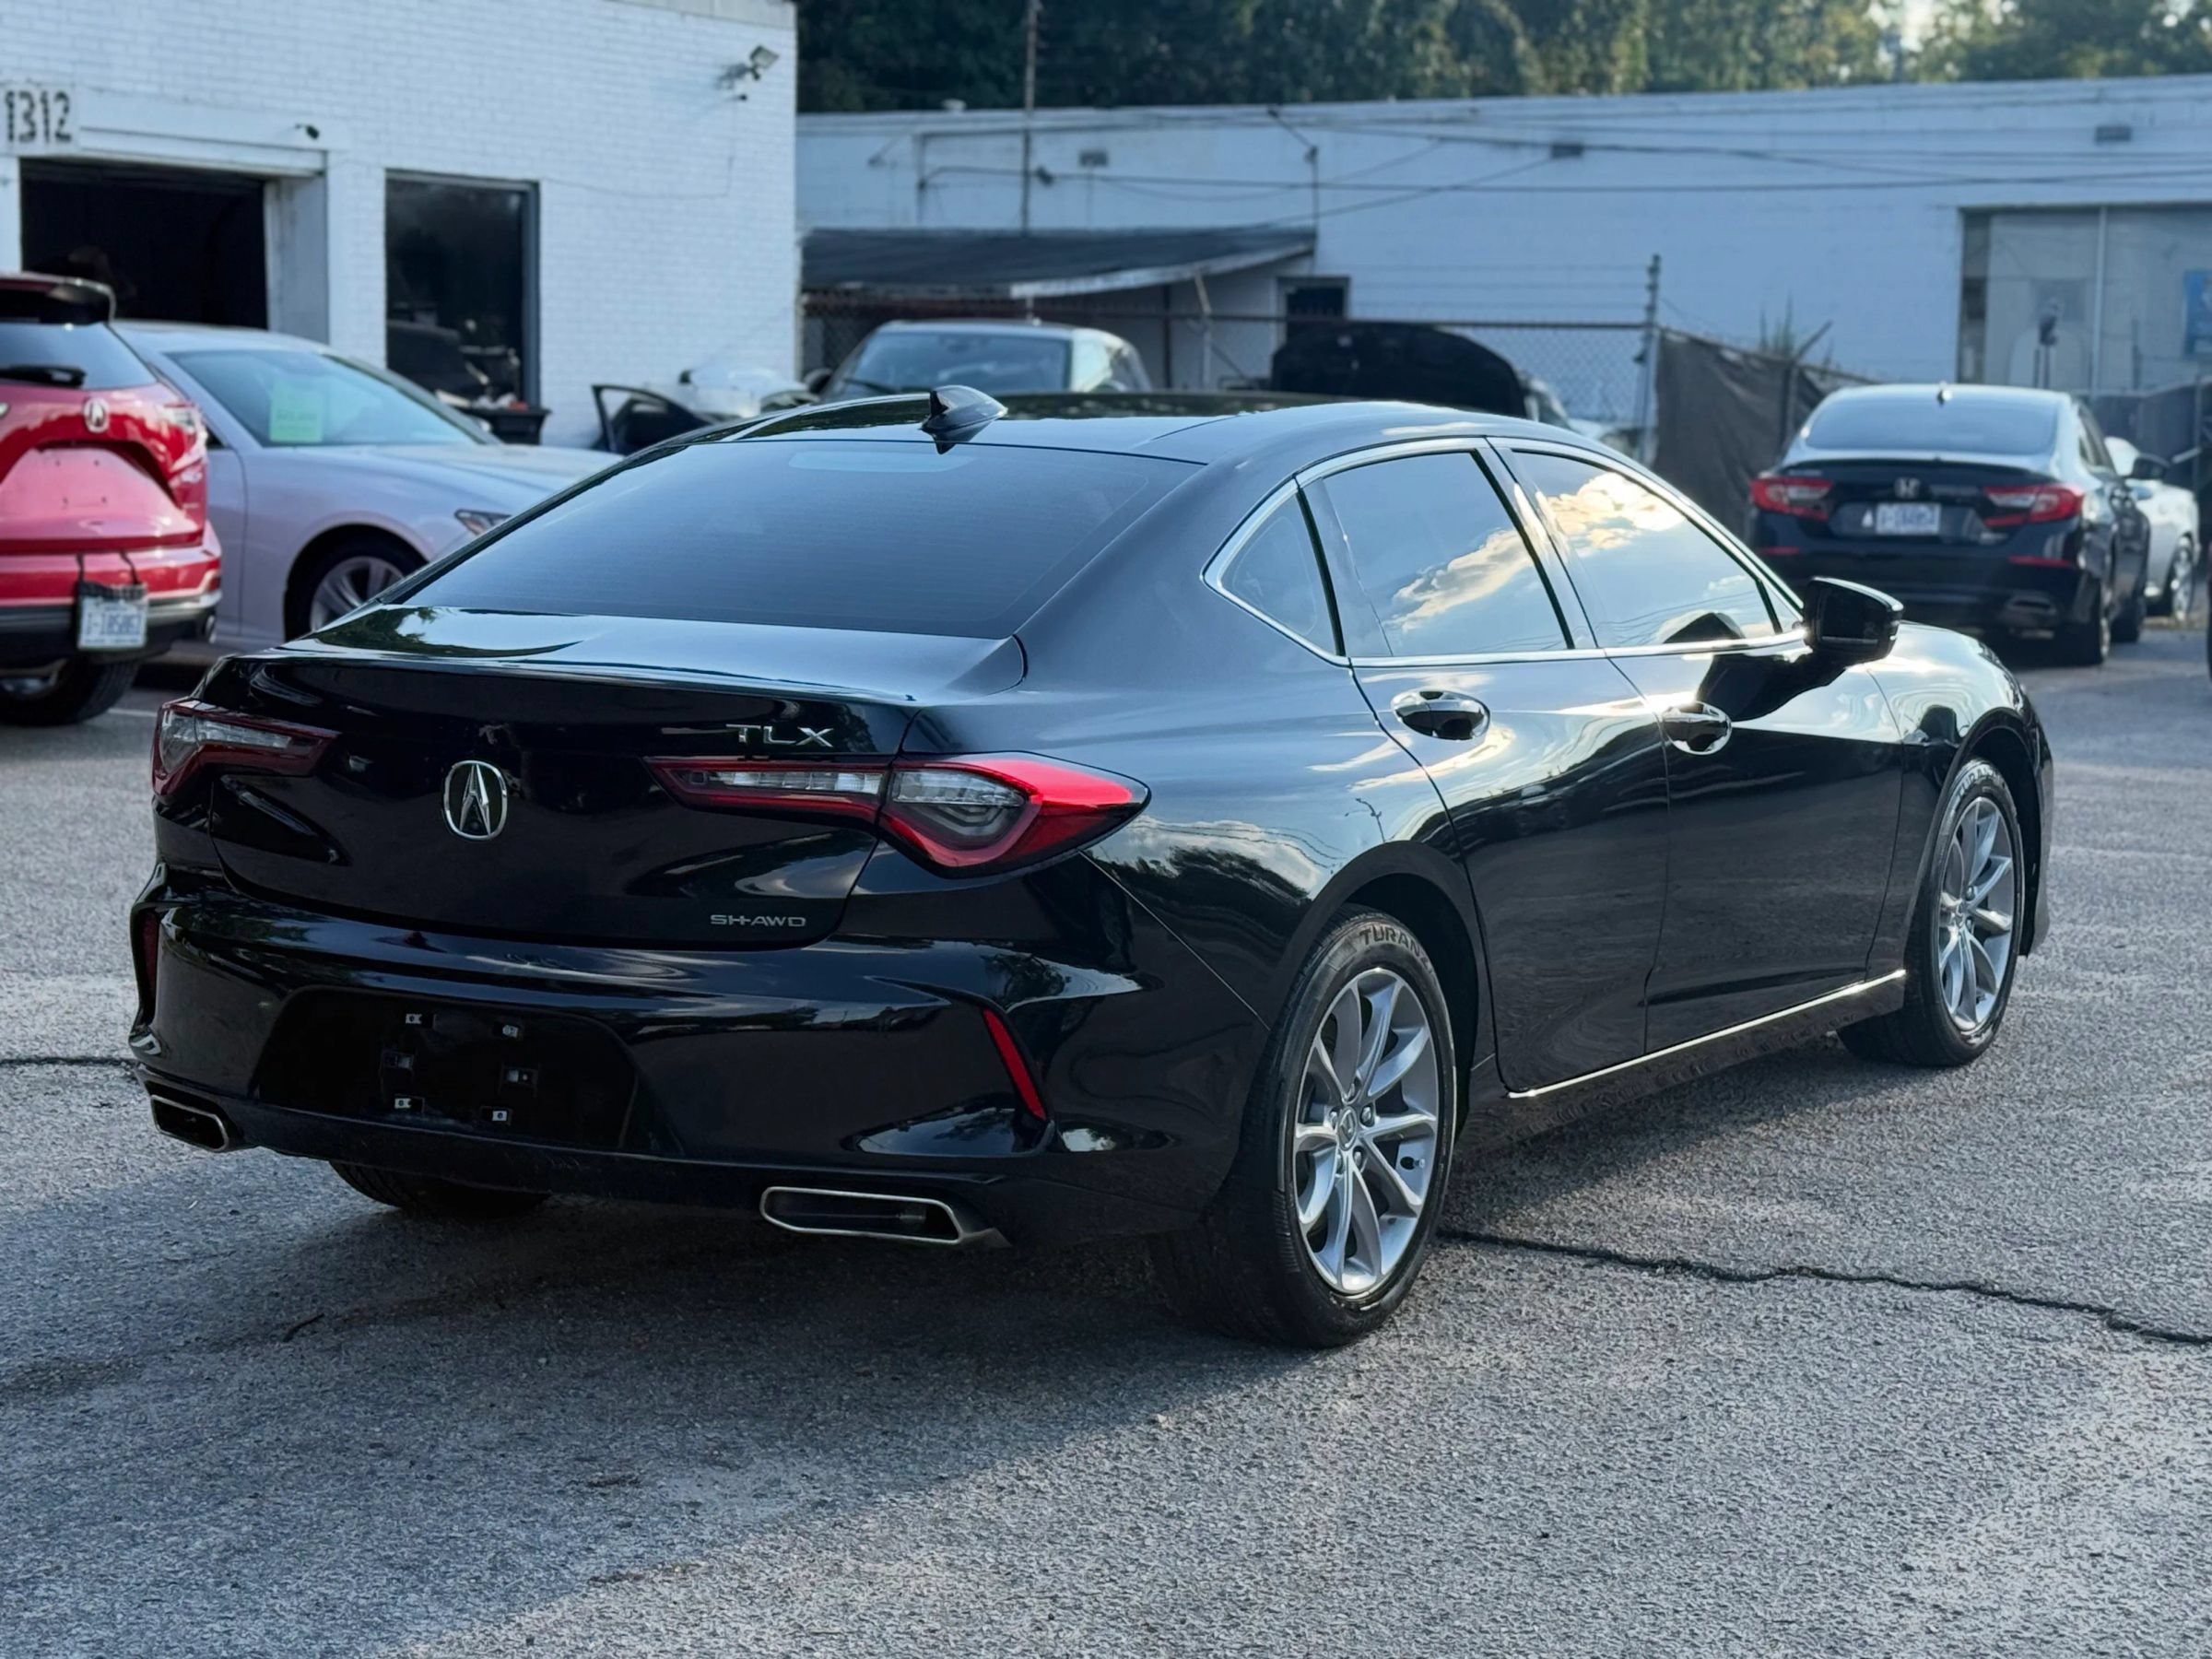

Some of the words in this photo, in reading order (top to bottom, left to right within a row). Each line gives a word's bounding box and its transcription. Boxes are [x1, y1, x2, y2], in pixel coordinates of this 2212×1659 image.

[5, 90, 72, 143] 1312
[725, 724, 833, 747] TLX
[710, 913, 806, 927] SH-AWD
